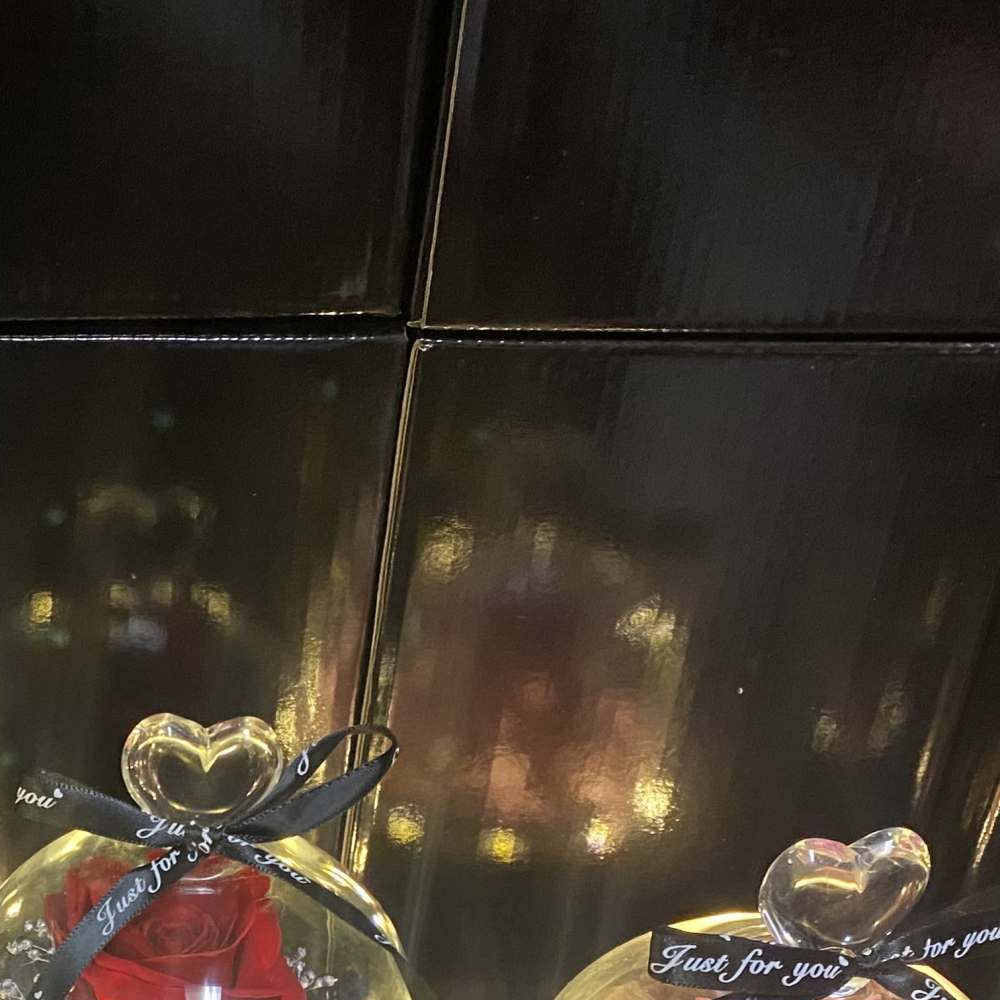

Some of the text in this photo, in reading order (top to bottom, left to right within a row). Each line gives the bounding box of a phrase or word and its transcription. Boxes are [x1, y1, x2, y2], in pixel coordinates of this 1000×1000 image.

[14, 786, 57, 809] you
[96, 849, 181, 937] Just for
[650, 944, 842, 988] Just for you
